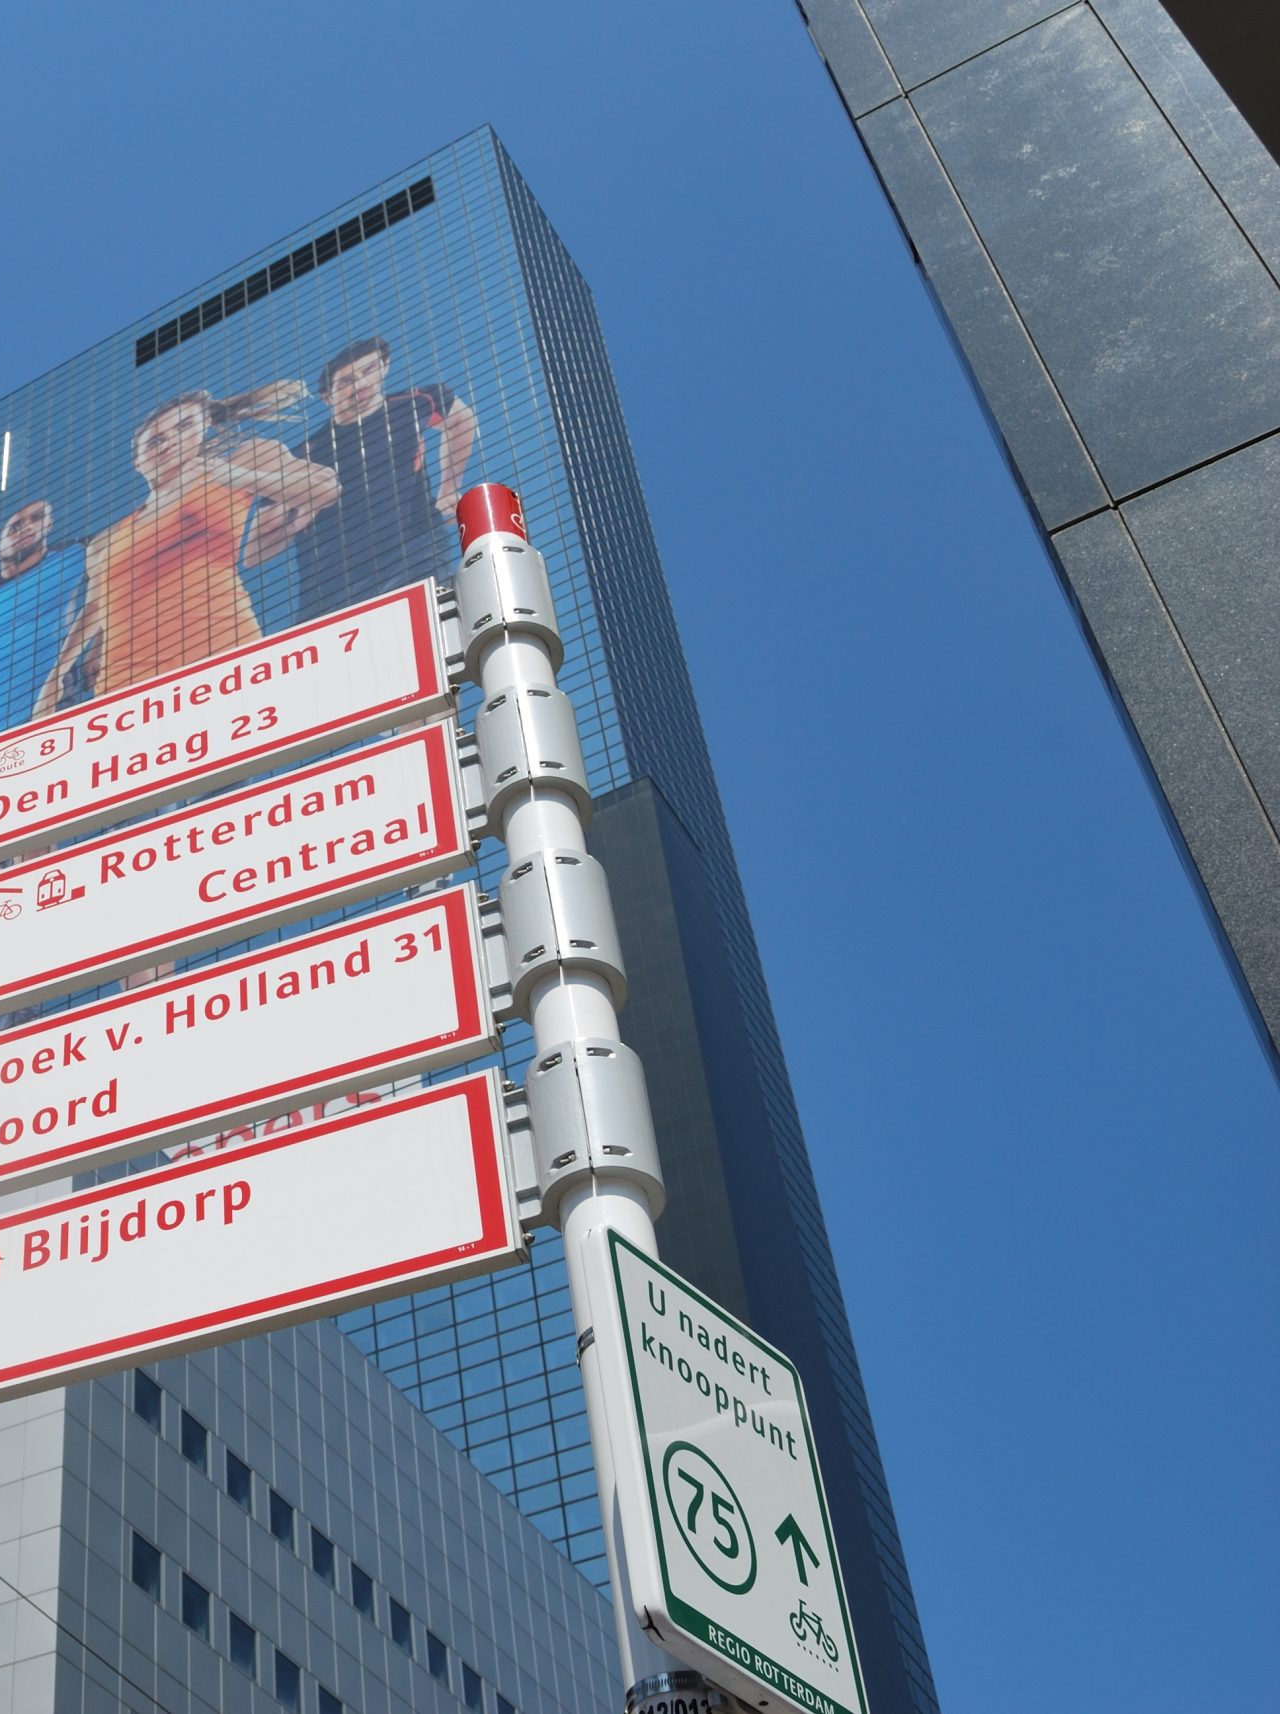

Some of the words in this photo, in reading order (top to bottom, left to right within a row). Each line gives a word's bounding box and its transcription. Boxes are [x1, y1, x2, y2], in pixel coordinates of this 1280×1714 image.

[86, 645, 319, 743] Schiedam
[339, 628, 359, 653] 7
[40, 738, 56, 757] 8
[91, 729, 209, 789] Haag
[230, 706, 278, 741] 23
[100, 774, 376, 885] Rotterdam
[198, 803, 429, 903] Centraal
[105, 1022, 143, 1051] v.
[165, 939, 372, 1035] Holland
[394, 923, 442, 964] 31
[22, 1180, 253, 1271] Blijdorp
[647, 1280, 666, 1317] U
[678, 1309, 773, 1396] nadert
[640, 1322, 798, 1461] knooppunt
[677, 1467, 740, 1561] 75
[708, 1624, 751, 1665] REGIO
